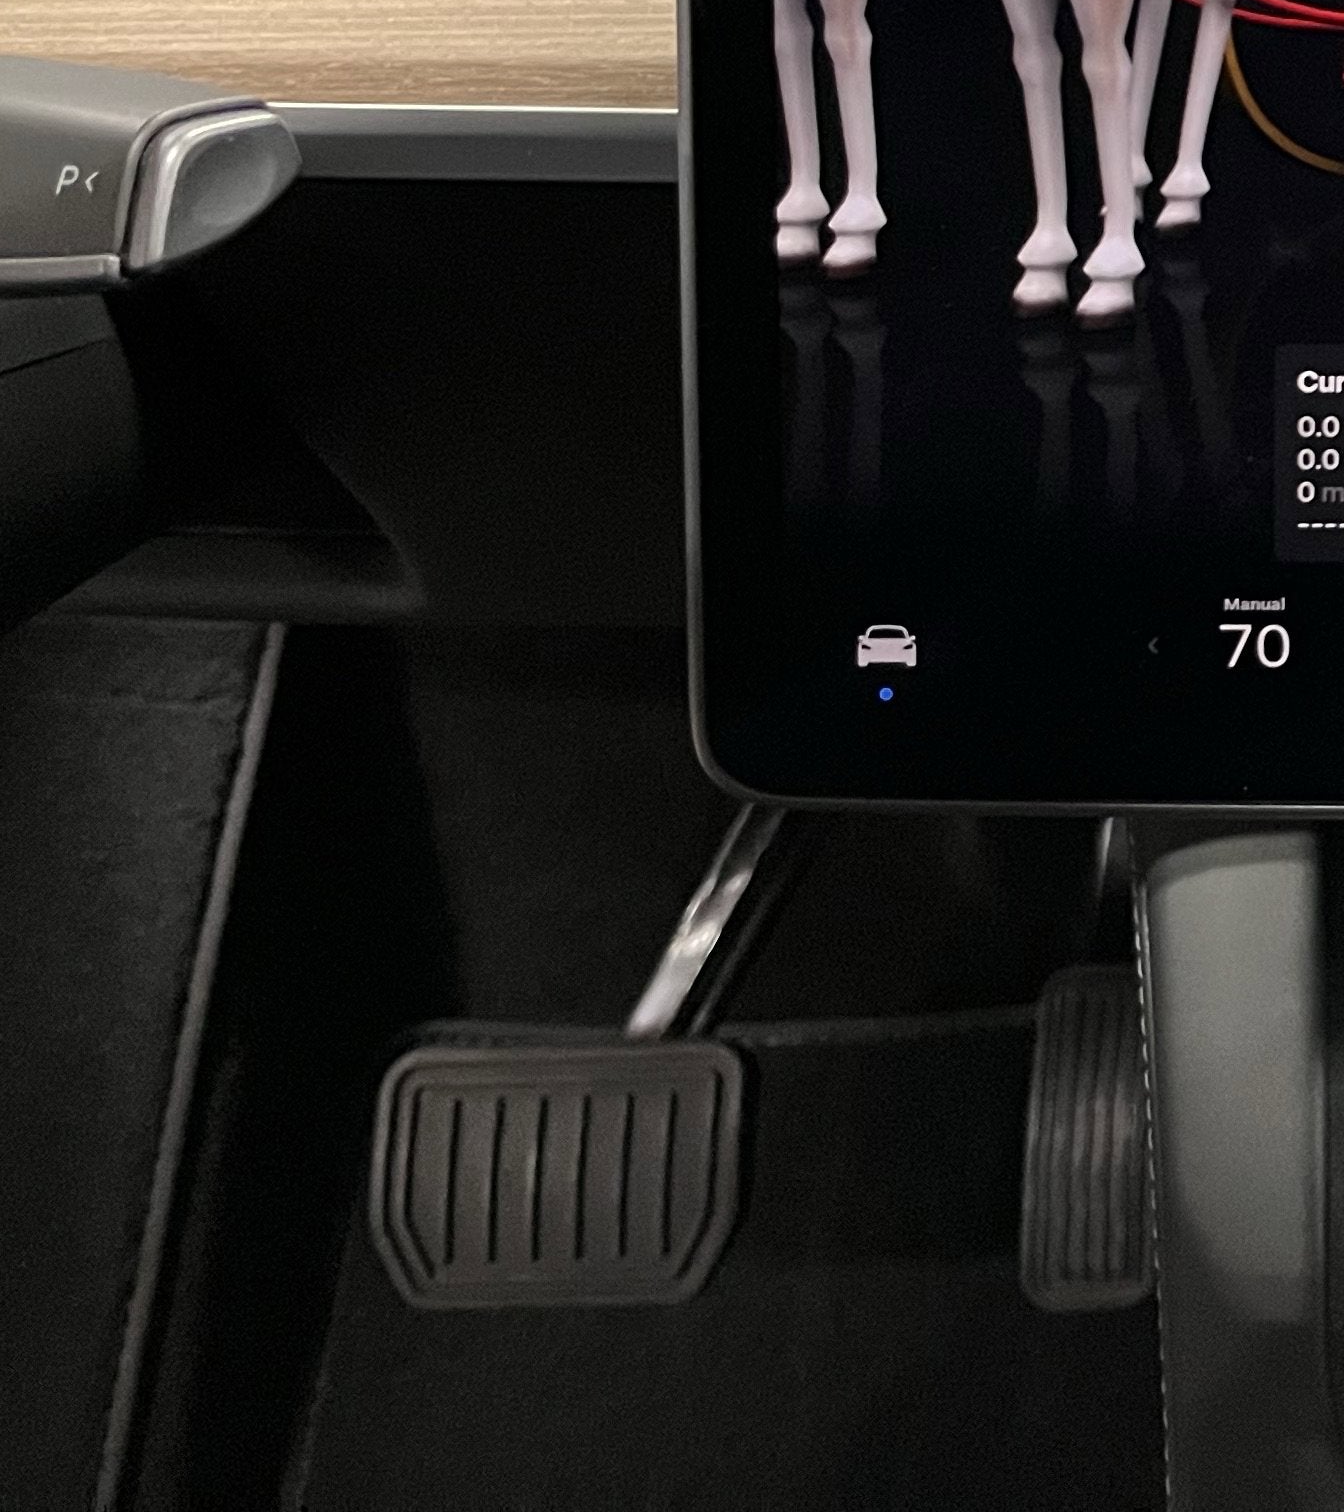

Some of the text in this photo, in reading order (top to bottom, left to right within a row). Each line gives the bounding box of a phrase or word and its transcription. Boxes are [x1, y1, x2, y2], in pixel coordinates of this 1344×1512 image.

[1297, 415, 1340, 438] 0.0
[1296, 448, 1340, 471] 0.0
[1296, 481, 1316, 503] 0
[1223, 596, 1286, 611] Manual
[1218, 623, 1290, 668] 70
